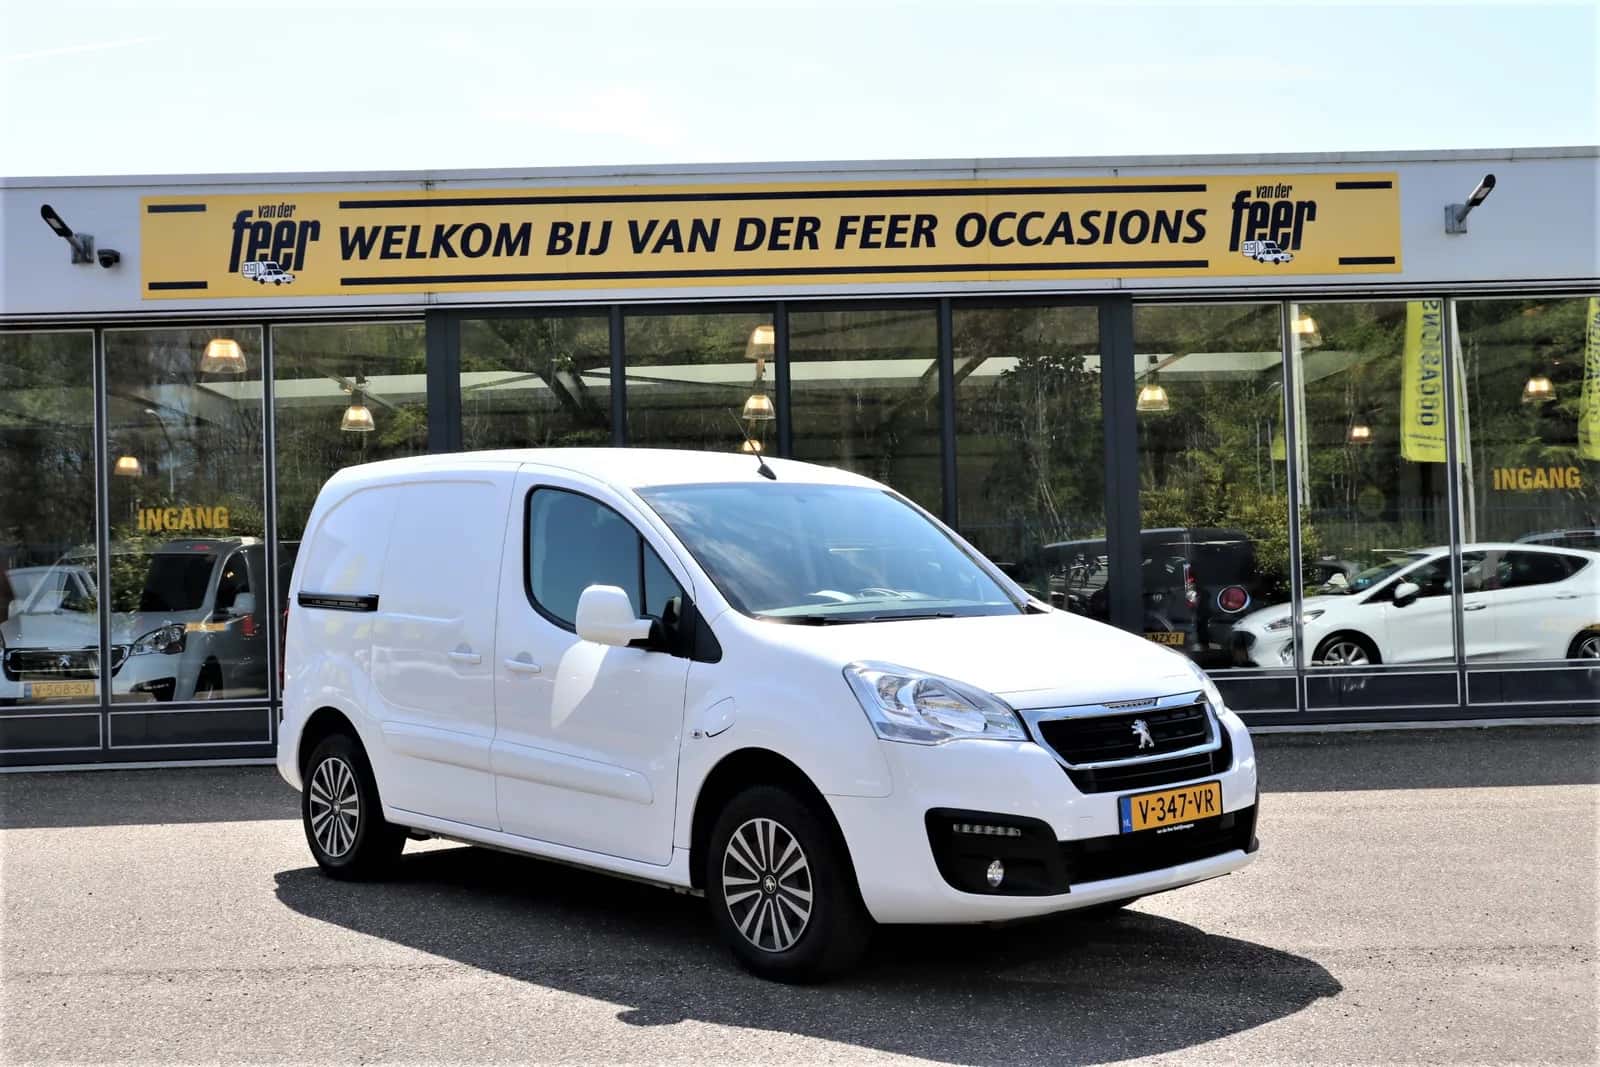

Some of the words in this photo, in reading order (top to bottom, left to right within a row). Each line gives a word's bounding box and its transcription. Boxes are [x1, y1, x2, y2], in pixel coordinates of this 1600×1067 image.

[1256, 184, 1274, 199] van
[1275, 183, 1292, 199] der
[258, 204, 277, 219] van
[277, 202, 296, 218] der
[1229, 190, 1317, 252] feer
[229, 209, 321, 273] feer
[339, 222, 532, 260] WELKOM
[545, 220, 612, 256] BIJ
[627, 218, 721, 255] VAN
[733, 216, 822, 252] DER
[834, 213, 938, 250] FEER
[955, 208, 1208, 248] OCCASIONS
[1493, 466, 1582, 490] INGANG
[137, 505, 230, 530] INGANG
[1138, 789, 1215, 825] V-347-VR
